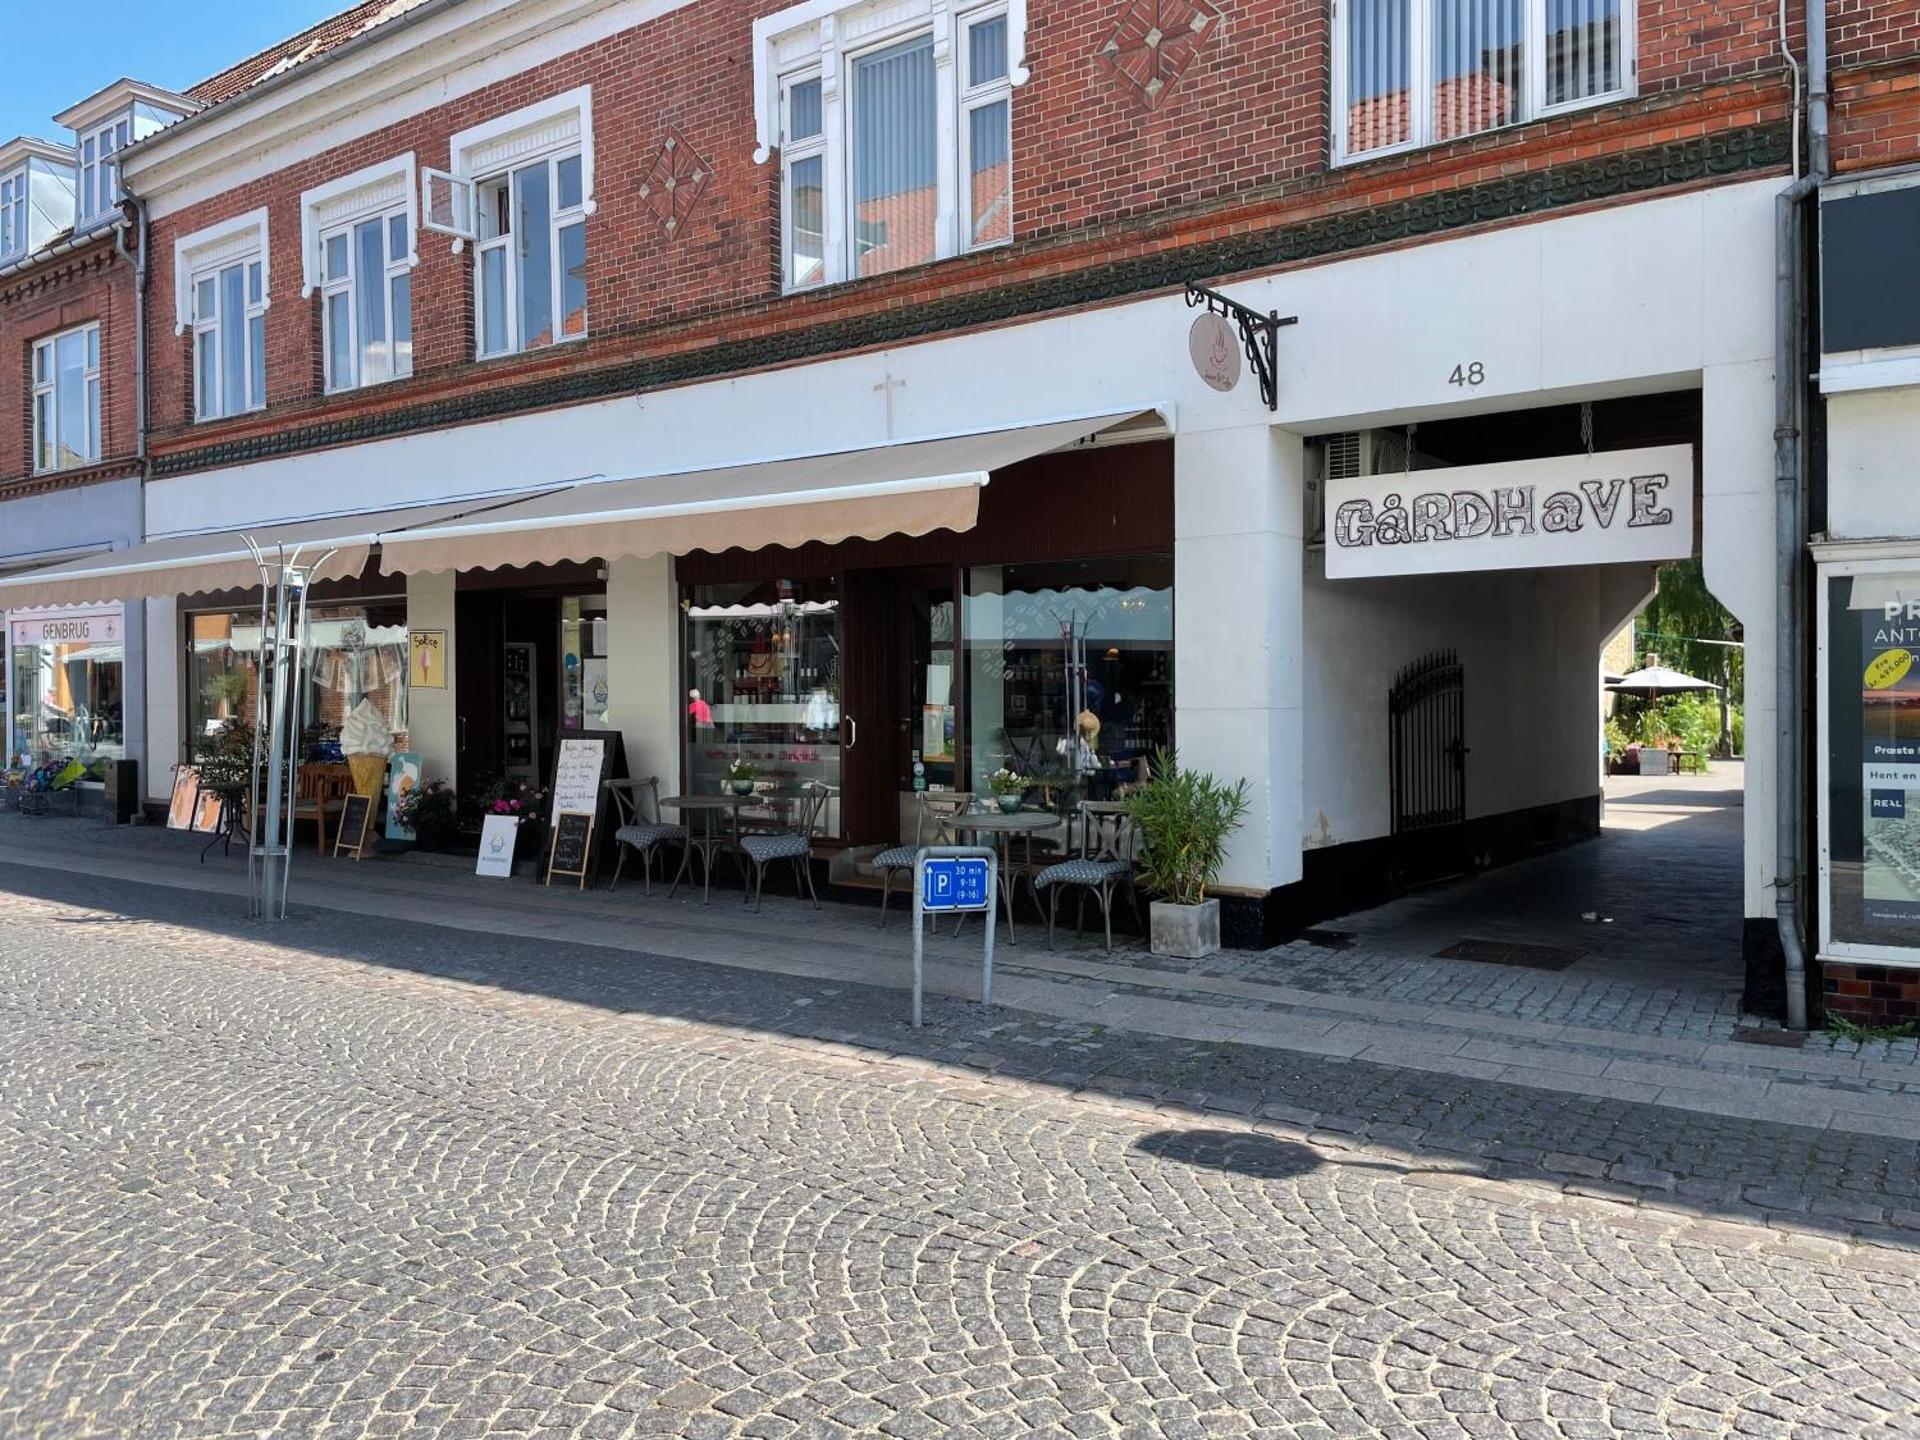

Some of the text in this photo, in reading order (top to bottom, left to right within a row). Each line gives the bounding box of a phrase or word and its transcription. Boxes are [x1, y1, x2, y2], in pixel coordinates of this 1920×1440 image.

[1448, 361, 1485, 387] 48
[42, 621, 89, 640] GENBRUG
[1870, 770, 1898, 780] Hent
[1873, 799, 1903, 808] REAL
[955, 866, 982, 876] 30 min
[938, 875, 948, 894] P
[960, 878, 977, 888] 9-18
